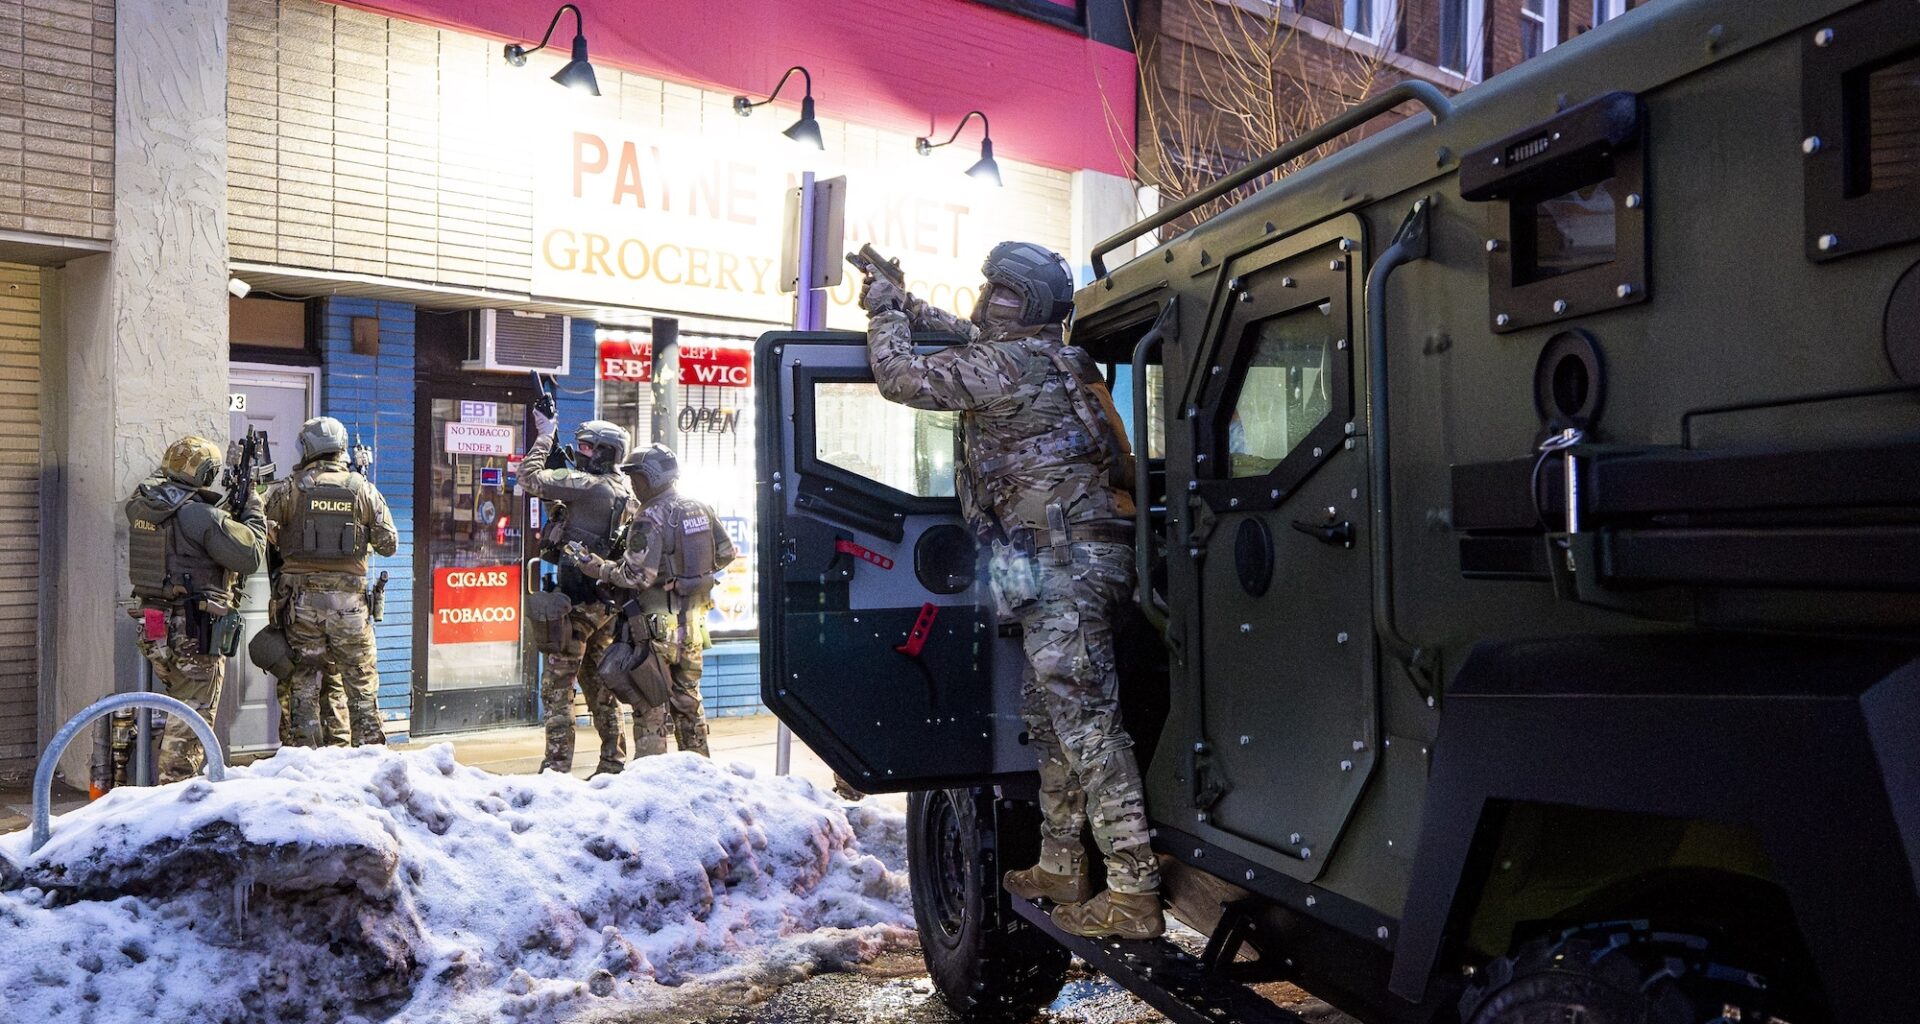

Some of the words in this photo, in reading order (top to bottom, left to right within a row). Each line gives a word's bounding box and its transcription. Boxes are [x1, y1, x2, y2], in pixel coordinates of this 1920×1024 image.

[573, 131, 757, 226] PAYNE
[542, 229, 774, 295] GROCERY
[678, 347, 719, 361] CEPT
[693, 364, 747, 384] WIC
[229, 396, 244, 410] 3
[462, 402, 496, 417] EBT
[678, 406, 741, 434] OPEN
[451, 426, 466, 435] NO
[467, 427, 510, 437] TOBACCO
[458, 442, 492, 452] UNDER
[495, 445, 502, 453] 21
[311, 500, 352, 511] POLICE
[682, 515, 709, 531] POLICE
[446, 571, 508, 588] CIGARS
[438, 606, 516, 624] TOBACCO
